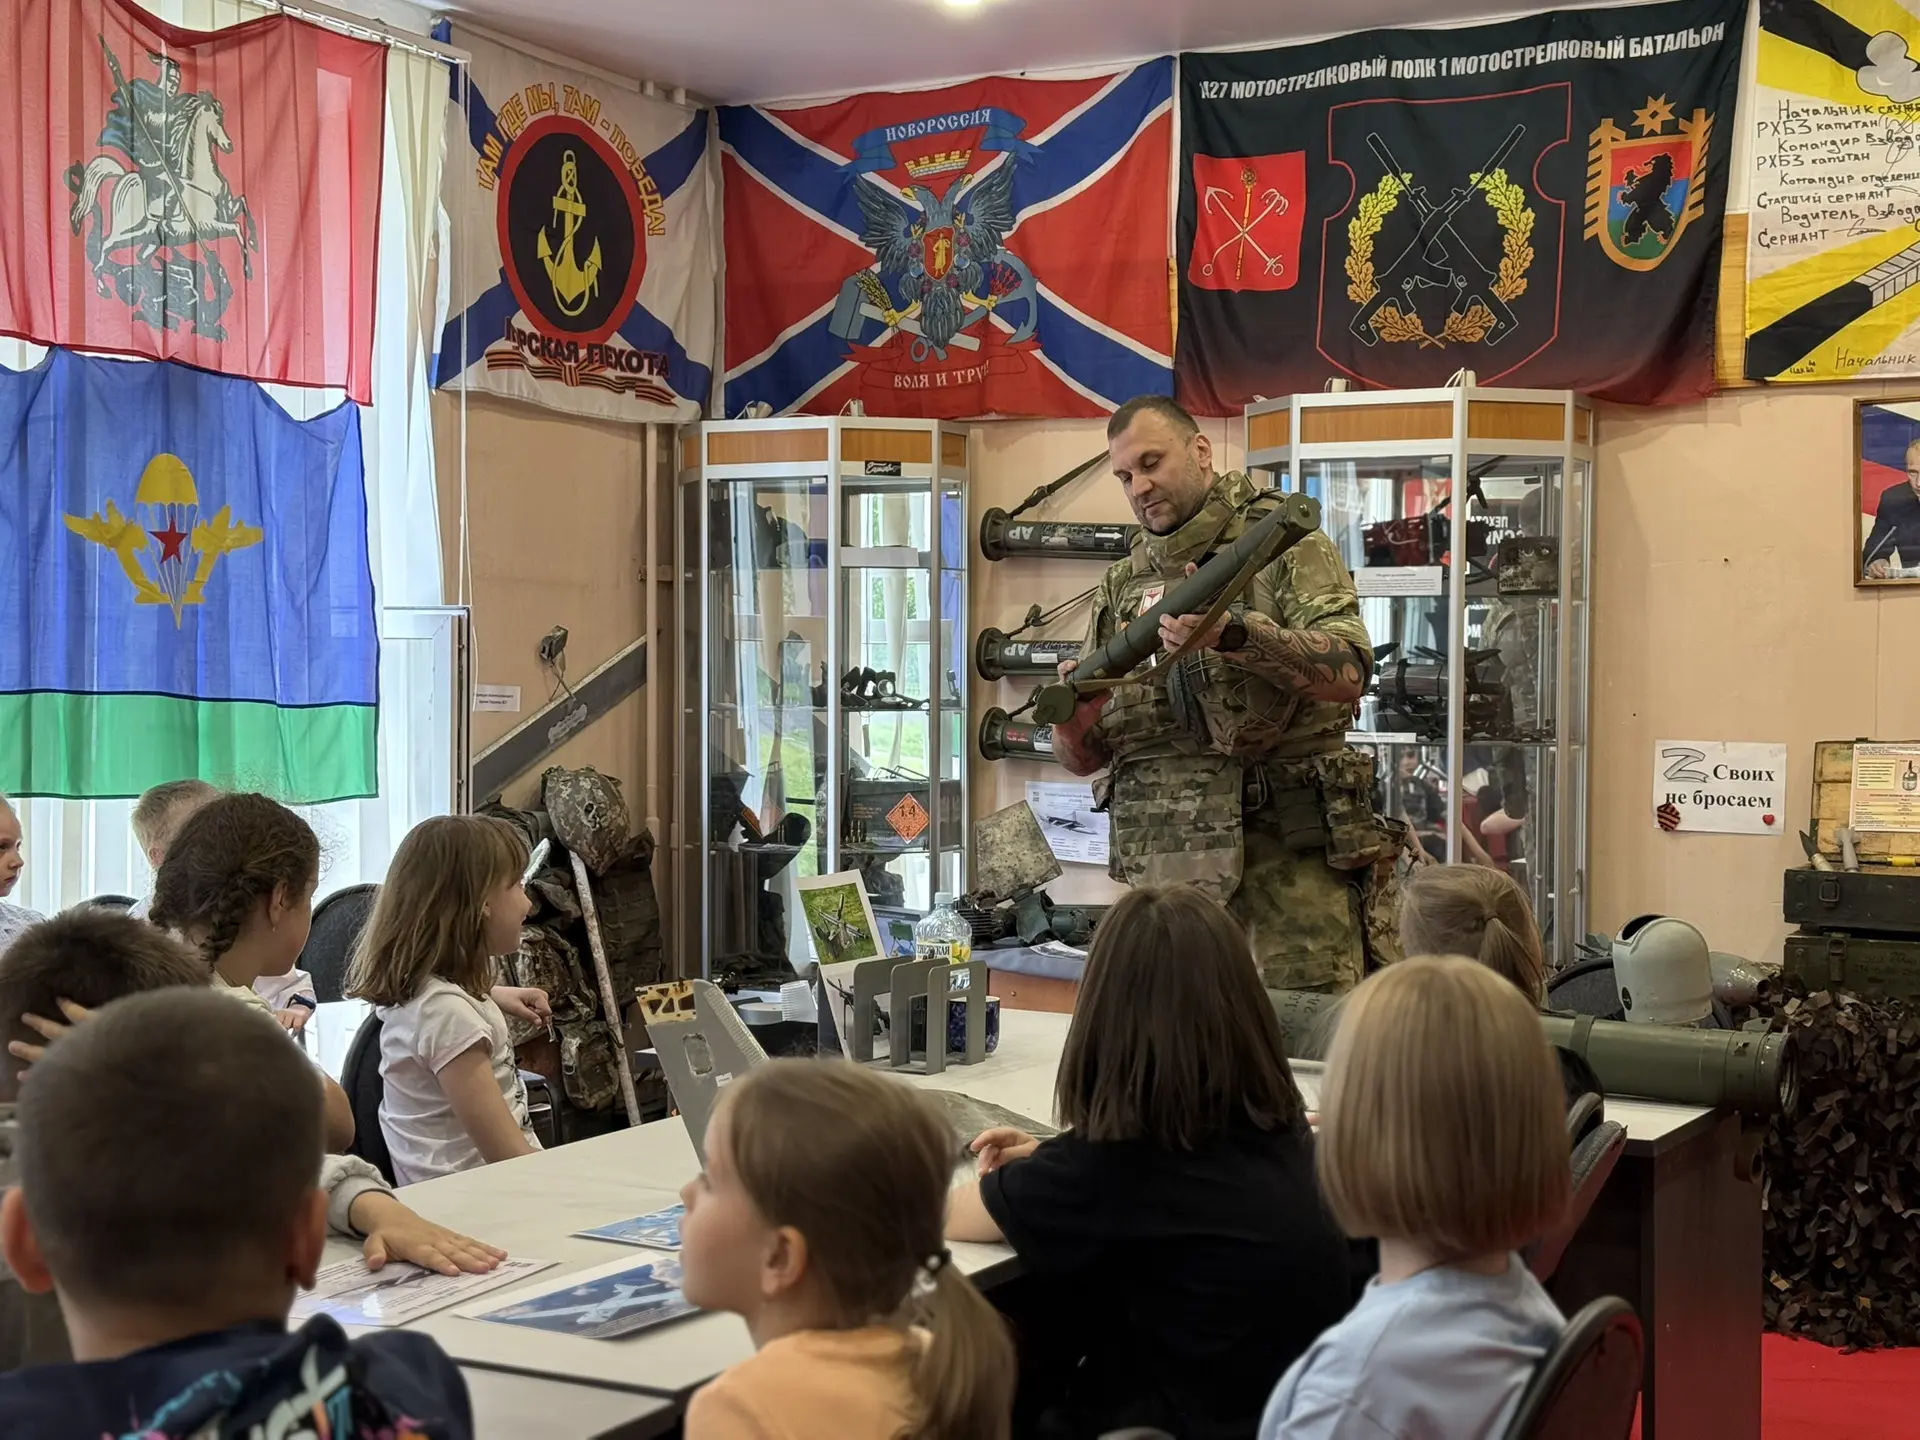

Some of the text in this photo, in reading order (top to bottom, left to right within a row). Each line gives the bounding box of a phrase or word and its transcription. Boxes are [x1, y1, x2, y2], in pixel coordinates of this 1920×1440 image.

[1230, 54, 1387, 99] МОТОСТРЕЛКОВЫЙ
[1391, 59, 1436, 80] ПОЛК
[1439, 59, 1448, 77] 1
[1451, 34, 1625, 76] МОТОСТРЕЛКОВЫЙ
[1628, 21, 1725, 58] БАТАЛЬОН
[885, 108, 992, 142] НОВОРОССИЯ
[1757, 119, 1811, 138] РХБЗ
[496, 92, 527, 141] ГДЕ
[525, 82, 559, 116] МЫ,
[564, 85, 601, 126] ТАМ
[609, 124, 666, 236] ПОБЕДА!
[1757, 154, 1804, 170] РХБЗ
[587, 343, 670, 377] ПЕХОТА
[1835, 346, 1917, 370] Начальник
[894, 373, 930, 389] ВОЛЯ
[935, 371, 948, 387] И
[1712, 764, 1775, 782] Своих
[1665, 790, 1772, 810] не бросаем
